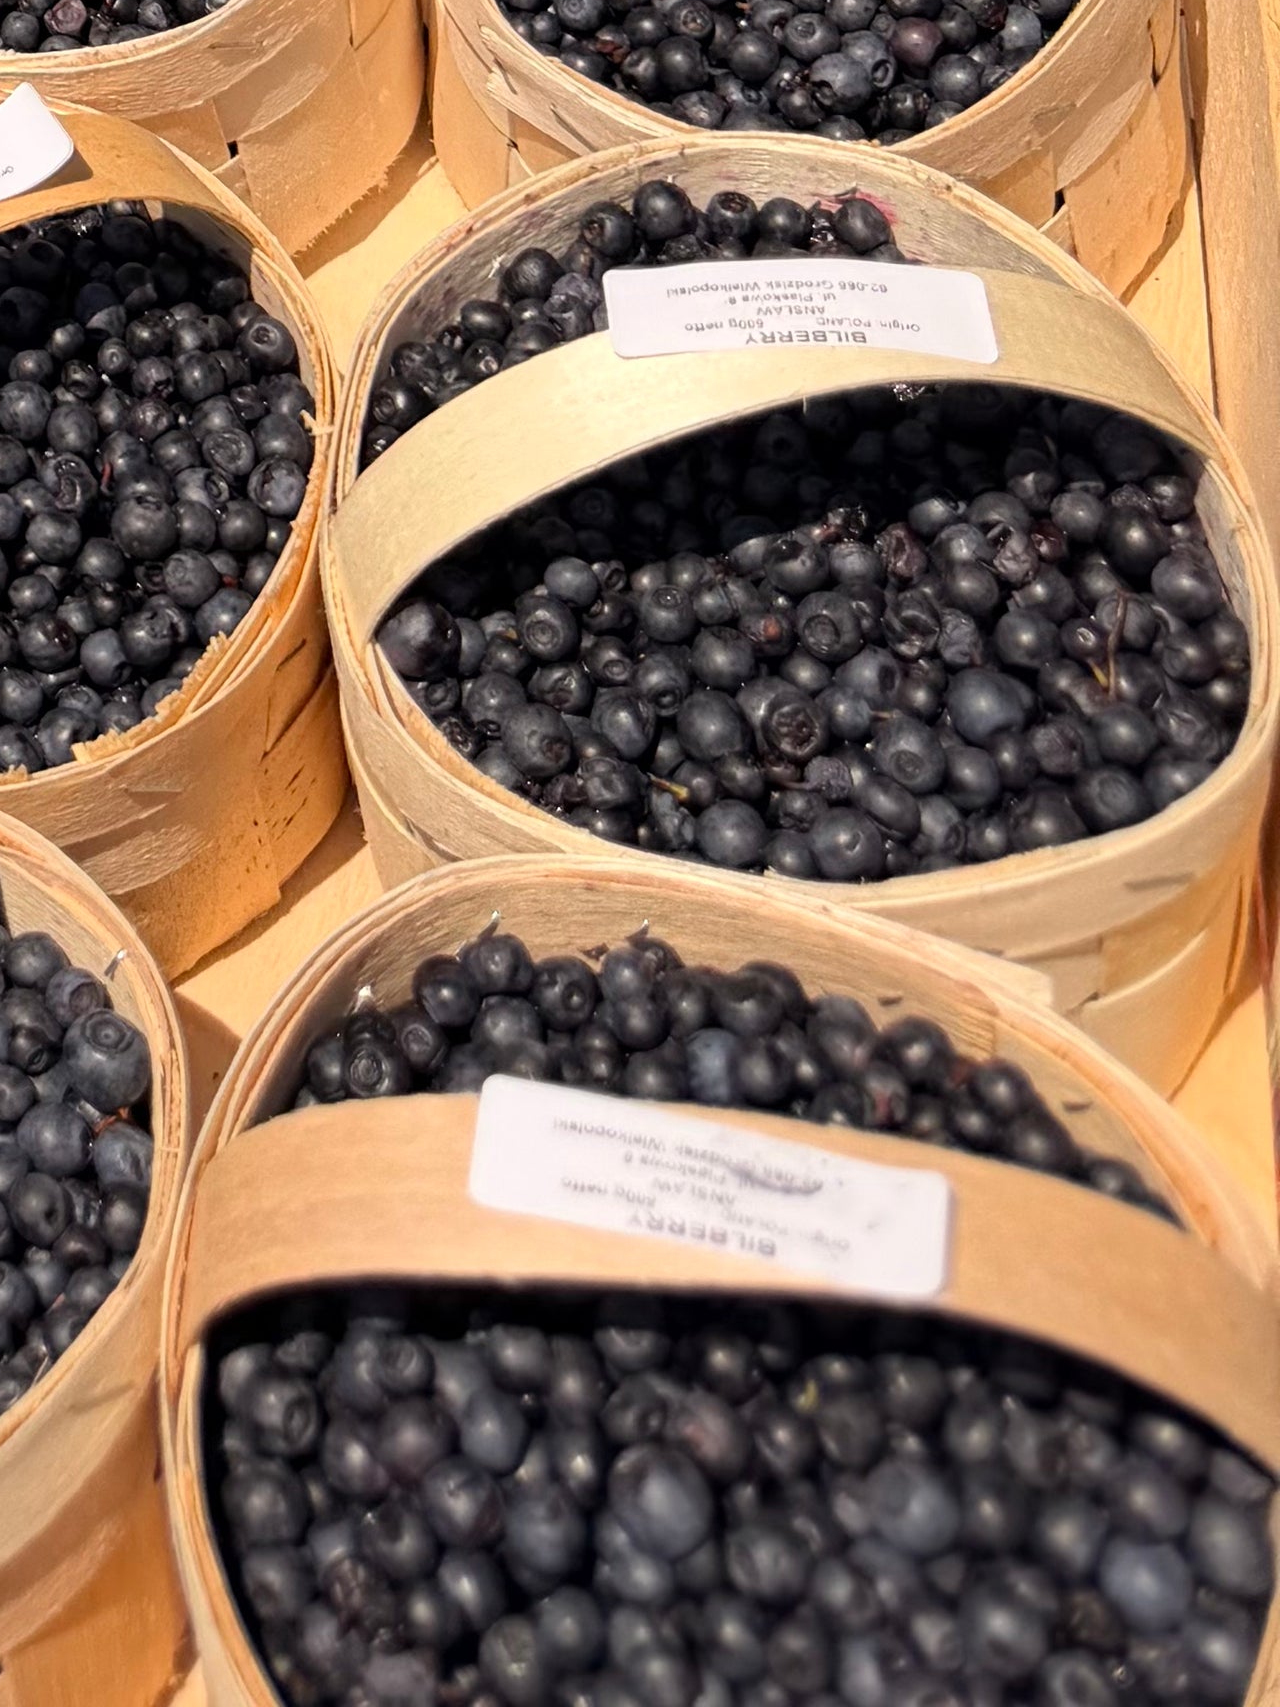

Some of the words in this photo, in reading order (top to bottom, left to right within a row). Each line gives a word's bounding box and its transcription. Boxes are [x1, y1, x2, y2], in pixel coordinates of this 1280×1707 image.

[756, 304, 825, 315] ANSLAW
[684, 321, 723, 332] netto
[745, 329, 867, 344] BILBERRY
[632, 1213, 776, 1258] BILBERRY
